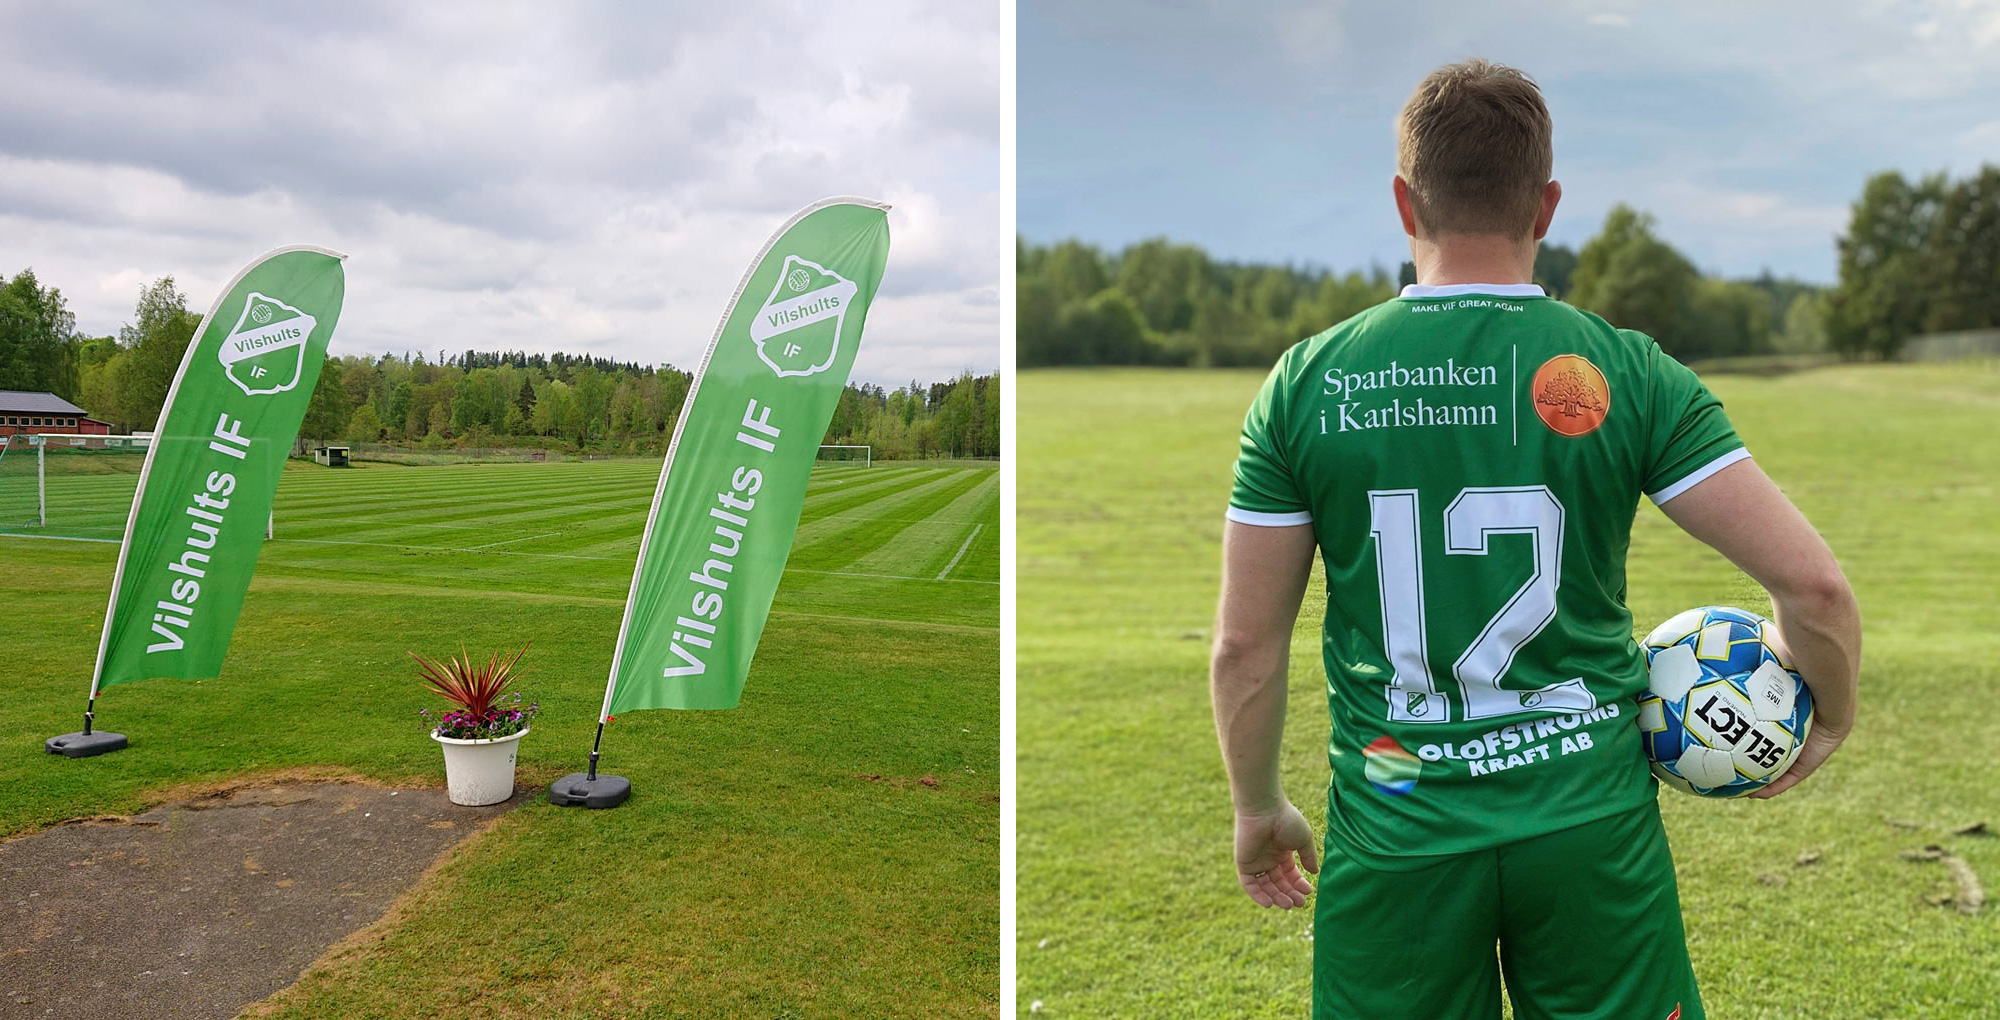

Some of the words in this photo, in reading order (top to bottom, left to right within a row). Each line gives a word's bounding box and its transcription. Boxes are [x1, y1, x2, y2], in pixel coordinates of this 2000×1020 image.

[768, 296, 840, 328] Vilshults
[1411, 304, 1440, 313] MAKE
[1442, 301, 1456, 311] VIF
[1459, 300, 1492, 309] GREAT
[1494, 302, 1524, 312] AGAIN
[234, 328, 301, 353] Vilshults
[783, 342, 802, 358] IF
[250, 365, 268, 379] IF
[1323, 358, 1498, 402] Sparbanken
[1319, 409, 1328, 435] i
[1337, 397, 1498, 433] Karlshamn
[146, 470, 236, 655] Vilshults
[209, 413, 251, 460] IF
[663, 465, 764, 678] Vilshults
[735, 398, 782, 454] IF
[1368, 484, 1598, 724] 12
[1722, 696, 1747, 719] NUMERO
[1765, 690, 1781, 705] IMS
[1694, 695, 1786, 769] SELECT
[1468, 743, 1551, 777] KRAFT
[1561, 731, 1594, 756] AB
